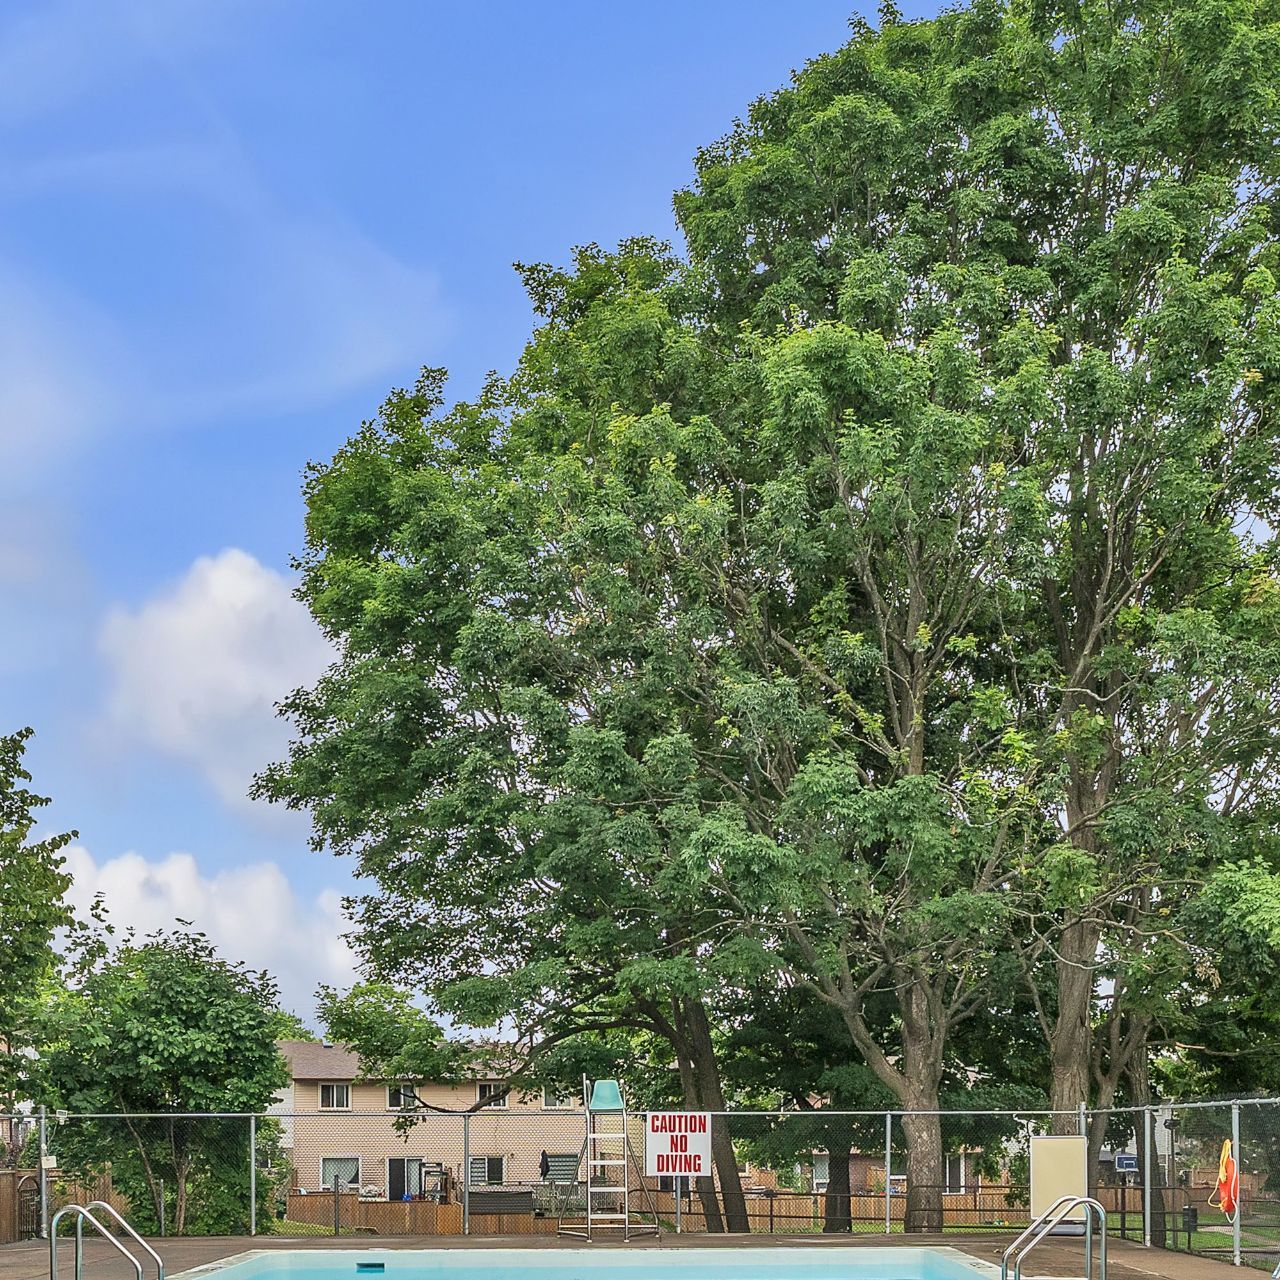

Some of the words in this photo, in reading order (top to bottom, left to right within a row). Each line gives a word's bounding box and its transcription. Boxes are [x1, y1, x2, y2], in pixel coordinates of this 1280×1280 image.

[651, 1114, 707, 1133] CAUTION
[670, 1134, 688, 1153] NO
[657, 1154, 702, 1173] DIVING
